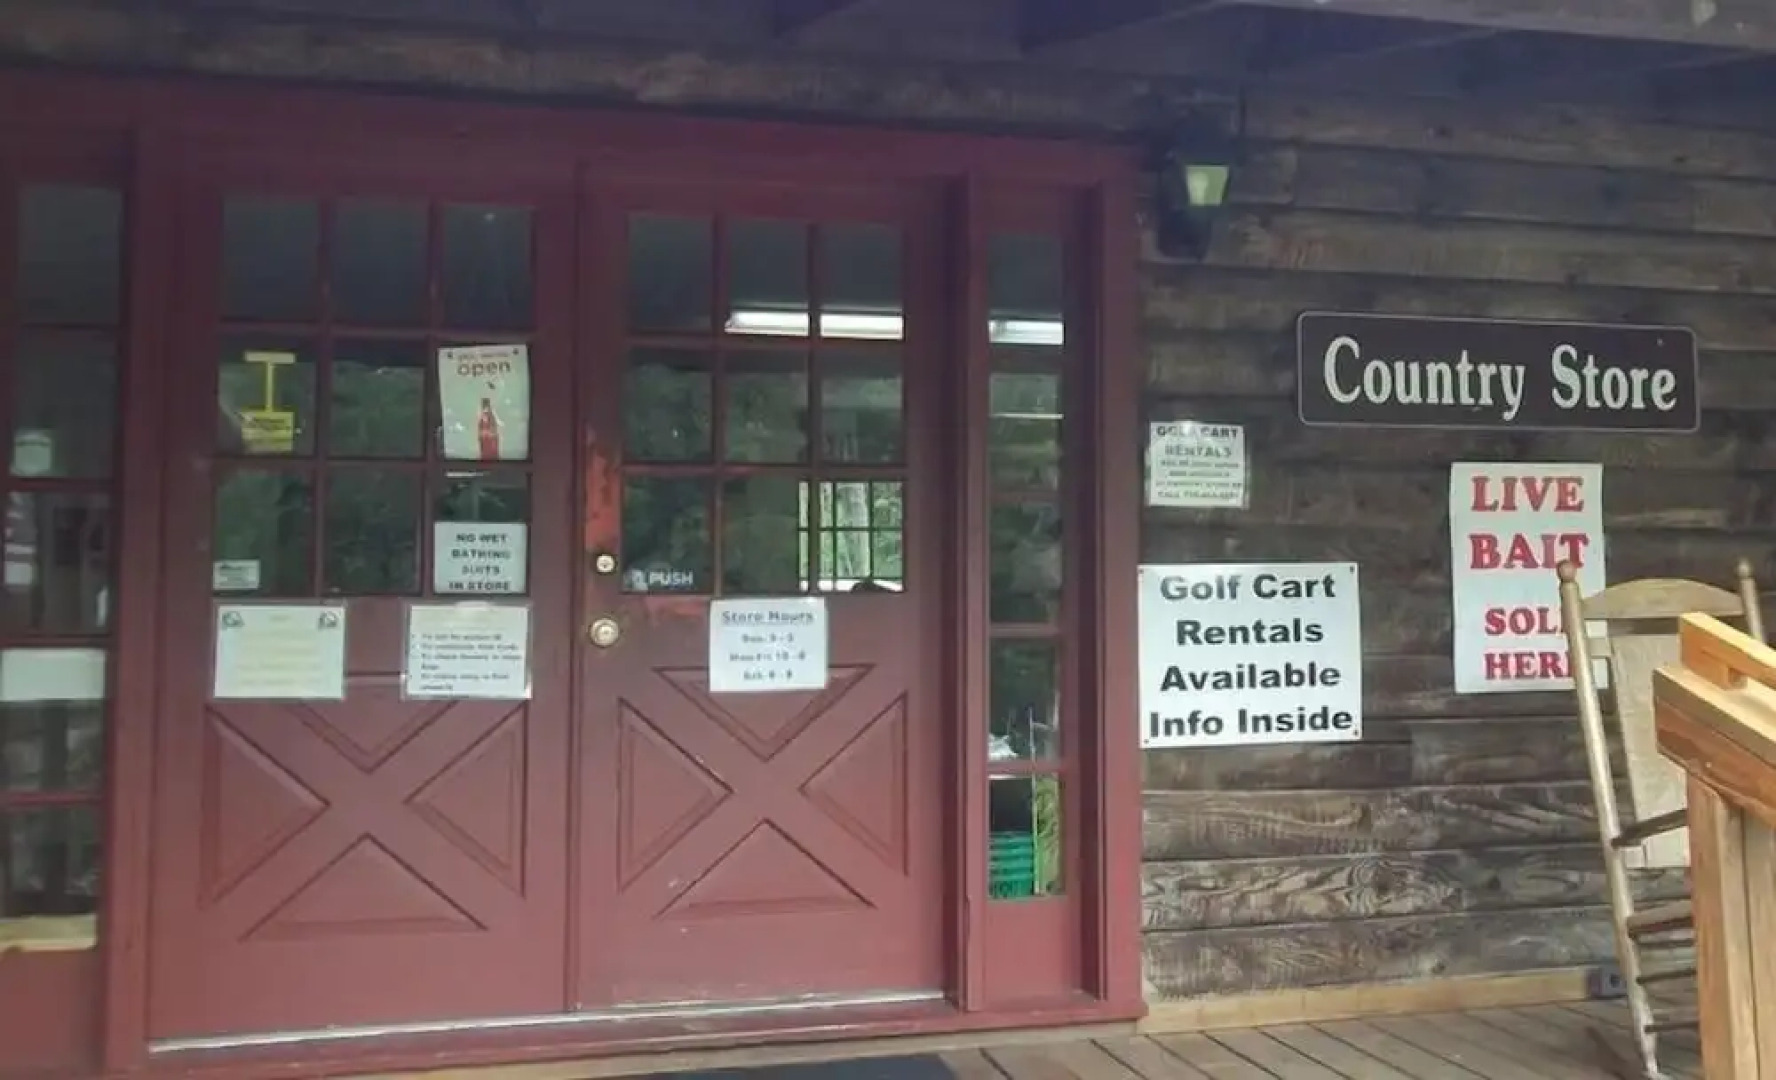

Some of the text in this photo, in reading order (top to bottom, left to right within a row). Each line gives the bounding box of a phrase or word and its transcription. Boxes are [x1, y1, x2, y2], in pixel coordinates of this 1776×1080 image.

[457, 360, 511, 377] open
[1323, 335, 1677, 422] Country Store
[1470, 475, 1585, 512] LIVE
[455, 532, 508, 543] NO WET
[1468, 532, 1590, 570] BAIT
[450, 548, 512, 559] BATHING
[467, 582, 509, 591] STORE
[649, 571, 694, 585] PUSH
[1160, 573, 1336, 601] Golf Cart
[722, 610, 814, 624] Store Hours
[1484, 607, 1566, 636] SOL
[1176, 617, 1324, 646] Rentals
[1160, 661, 1341, 692] Available
[1150, 705, 1353, 738] Info Inside
